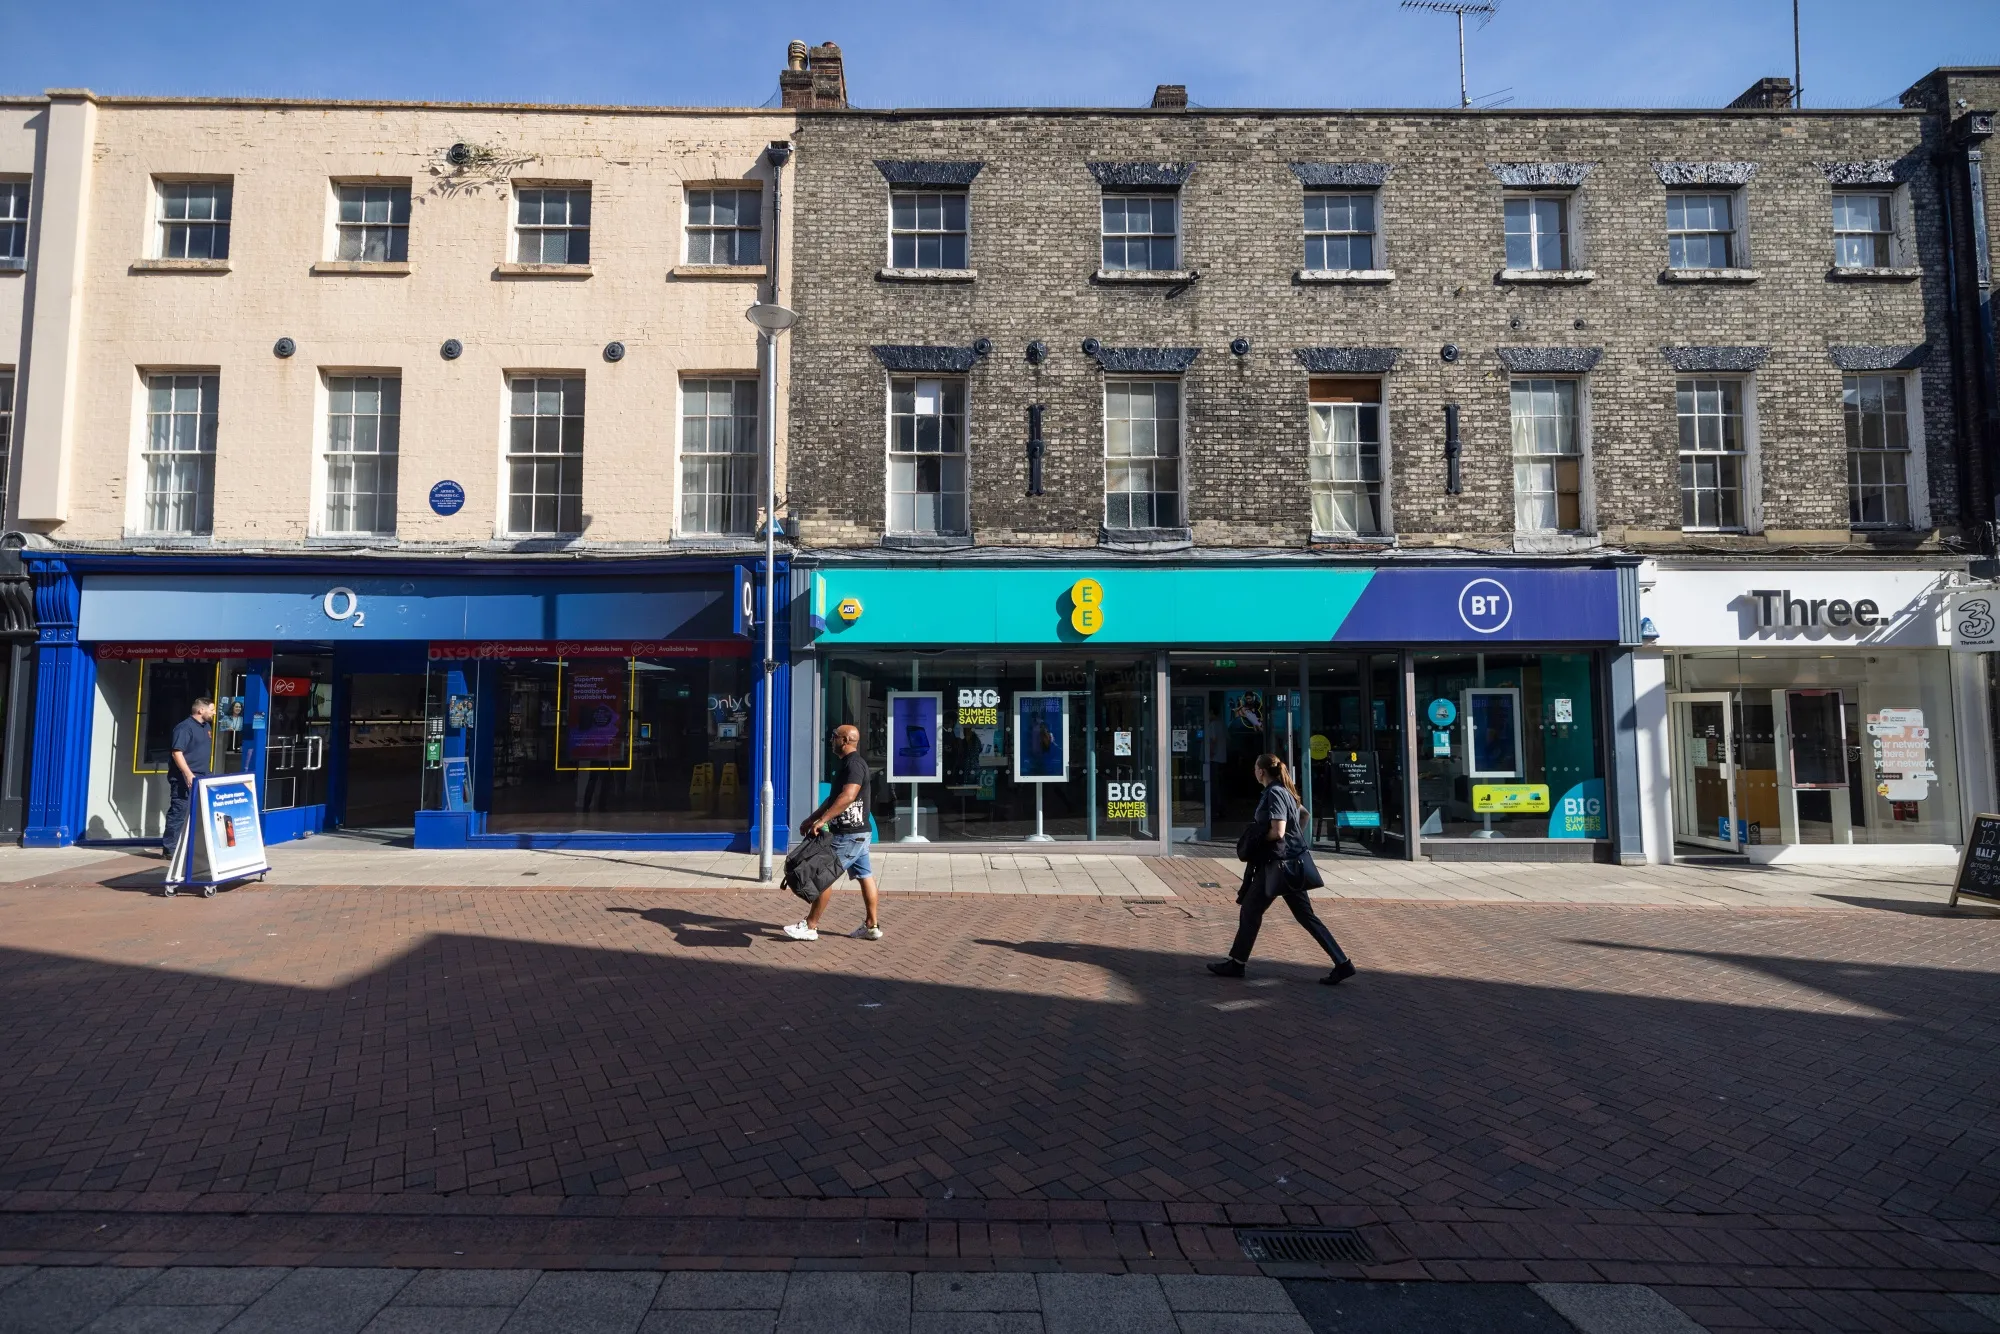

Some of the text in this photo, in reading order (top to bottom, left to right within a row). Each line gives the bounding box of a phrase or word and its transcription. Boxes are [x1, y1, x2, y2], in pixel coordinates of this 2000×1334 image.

[1471, 595, 1500, 616] BT
[1749, 589, 1889, 627] Three.
[1958, 598, 1995, 638] 3
[707, 694, 742, 712] Only
[959, 689, 997, 708] BIG
[958, 708, 997, 717] SUMMER
[958, 716, 997, 725] SAVERS
[1873, 739, 1930, 749] Our network
[1873, 749, 1919, 758] is here for
[1874, 758, 1935, 769] your network
[215, 792, 234, 801] Capture
[1107, 782, 1147, 801] BIG
[1107, 801, 1146, 810] SUMMER
[1564, 798, 1601, 816] BIG
[1108, 809, 1147, 819] SAVERS
[1565, 815, 1601, 824] SUMMER
[1981, 820, 1993, 828] UP
[1565, 824, 1601, 832] SAVERS
[1979, 830, 1996, 846] 12
[1975, 847, 1997, 859] HALF
